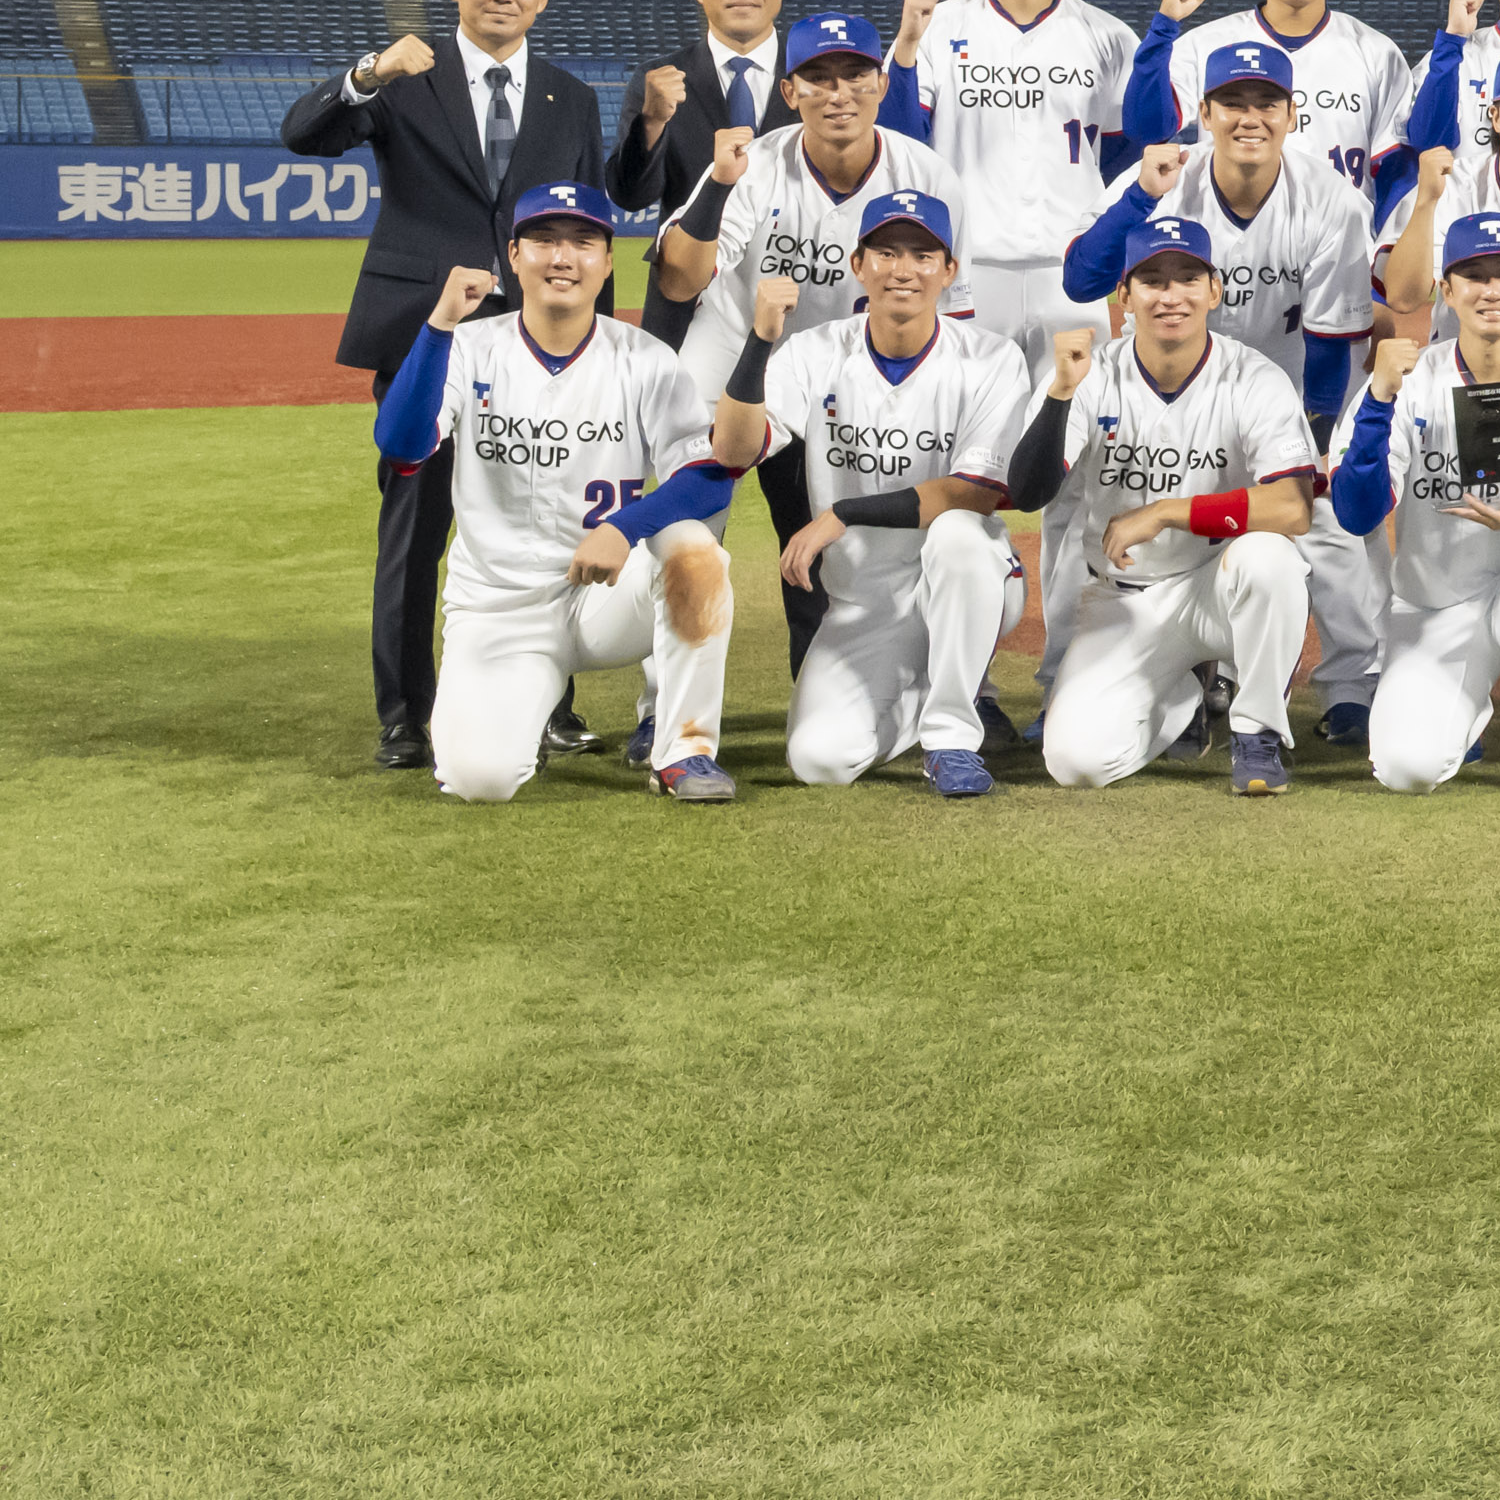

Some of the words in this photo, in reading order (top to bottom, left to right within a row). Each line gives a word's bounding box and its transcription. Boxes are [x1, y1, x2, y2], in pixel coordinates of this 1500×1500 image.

[959, 64, 1041, 85] TOKYO
[1048, 65, 1095, 88] GAS
[959, 88, 1044, 110] GROUP
[1315, 90, 1361, 113] GAS
[1328, 145, 1365, 188] 19
[759, 254, 845, 287] GROUP
[1258, 266, 1300, 285] GAS
[478, 413, 568, 440] TOKYO
[576, 421, 624, 443] GAS
[825, 421, 908, 451] TOKYO
[916, 430, 954, 453] GAS
[475, 441, 570, 467] GROUP
[826, 447, 912, 476] GROUP
[1103, 444, 1180, 470] TOKYO
[1188, 446, 1228, 471] GAS
[1099, 467, 1182, 494] GROUP
